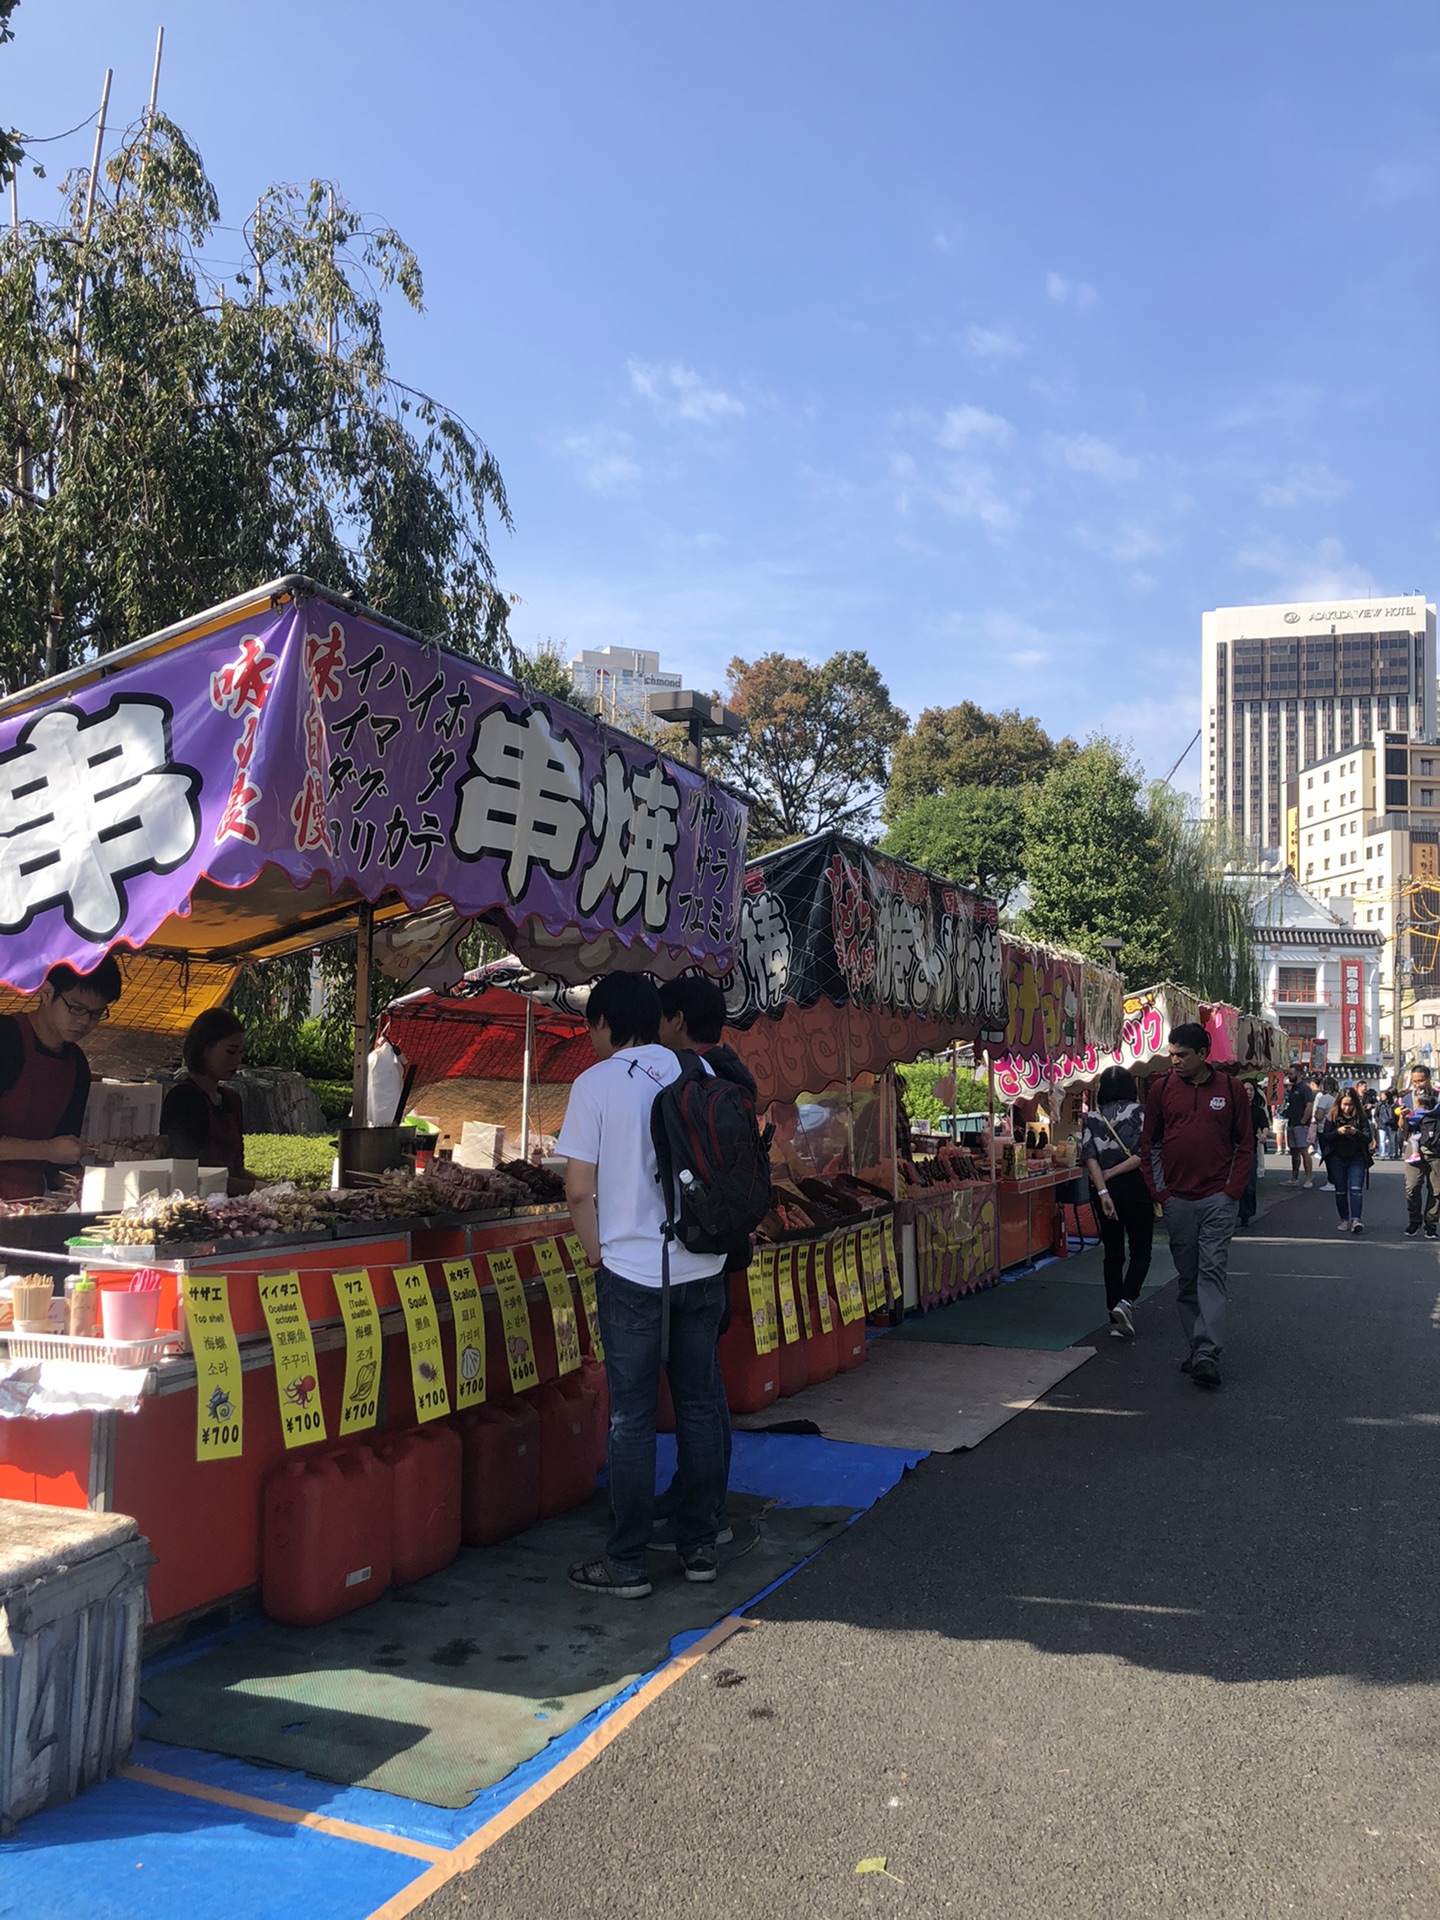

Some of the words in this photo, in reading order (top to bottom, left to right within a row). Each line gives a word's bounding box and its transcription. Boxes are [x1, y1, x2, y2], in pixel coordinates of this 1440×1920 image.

[1309, 611, 1353, 621] ASAKUSA
[1354, 608, 1382, 618] VIEW
[1385, 607, 1416, 617] HOTEL
[0, 692, 203, 943] 串
[451, 701, 682, 934] 串焼
[541, 1249, 553, 1261] タン
[492, 1257, 513, 1273] カルビ
[405, 1275, 421, 1290] イカ
[448, 1267, 471, 1282] ホタテ
[189, 1286, 222, 1301] サザエ
[261, 1283, 299, 1299] イイダコ
[453, 1288, 477, 1302] Scallop
[268, 1302, 298, 1314] Ocellated
[408, 1294, 428, 1309] Squid
[193, 1314, 207, 1324] Top
[209, 1313, 225, 1323] shell
[275, 1315, 300, 1325] octopus
[208, 1360, 229, 1377] 소라
[281, 1351, 311, 1371] 주꾸미
[512, 1360, 535, 1380] ¥600
[460, 1377, 484, 1397] ¥700
[418, 1388, 446, 1410] ¥700
[344, 1400, 375, 1422] ¥700
[285, 1411, 320, 1433] ¥700
[202, 1424, 239, 1446] ¥700
